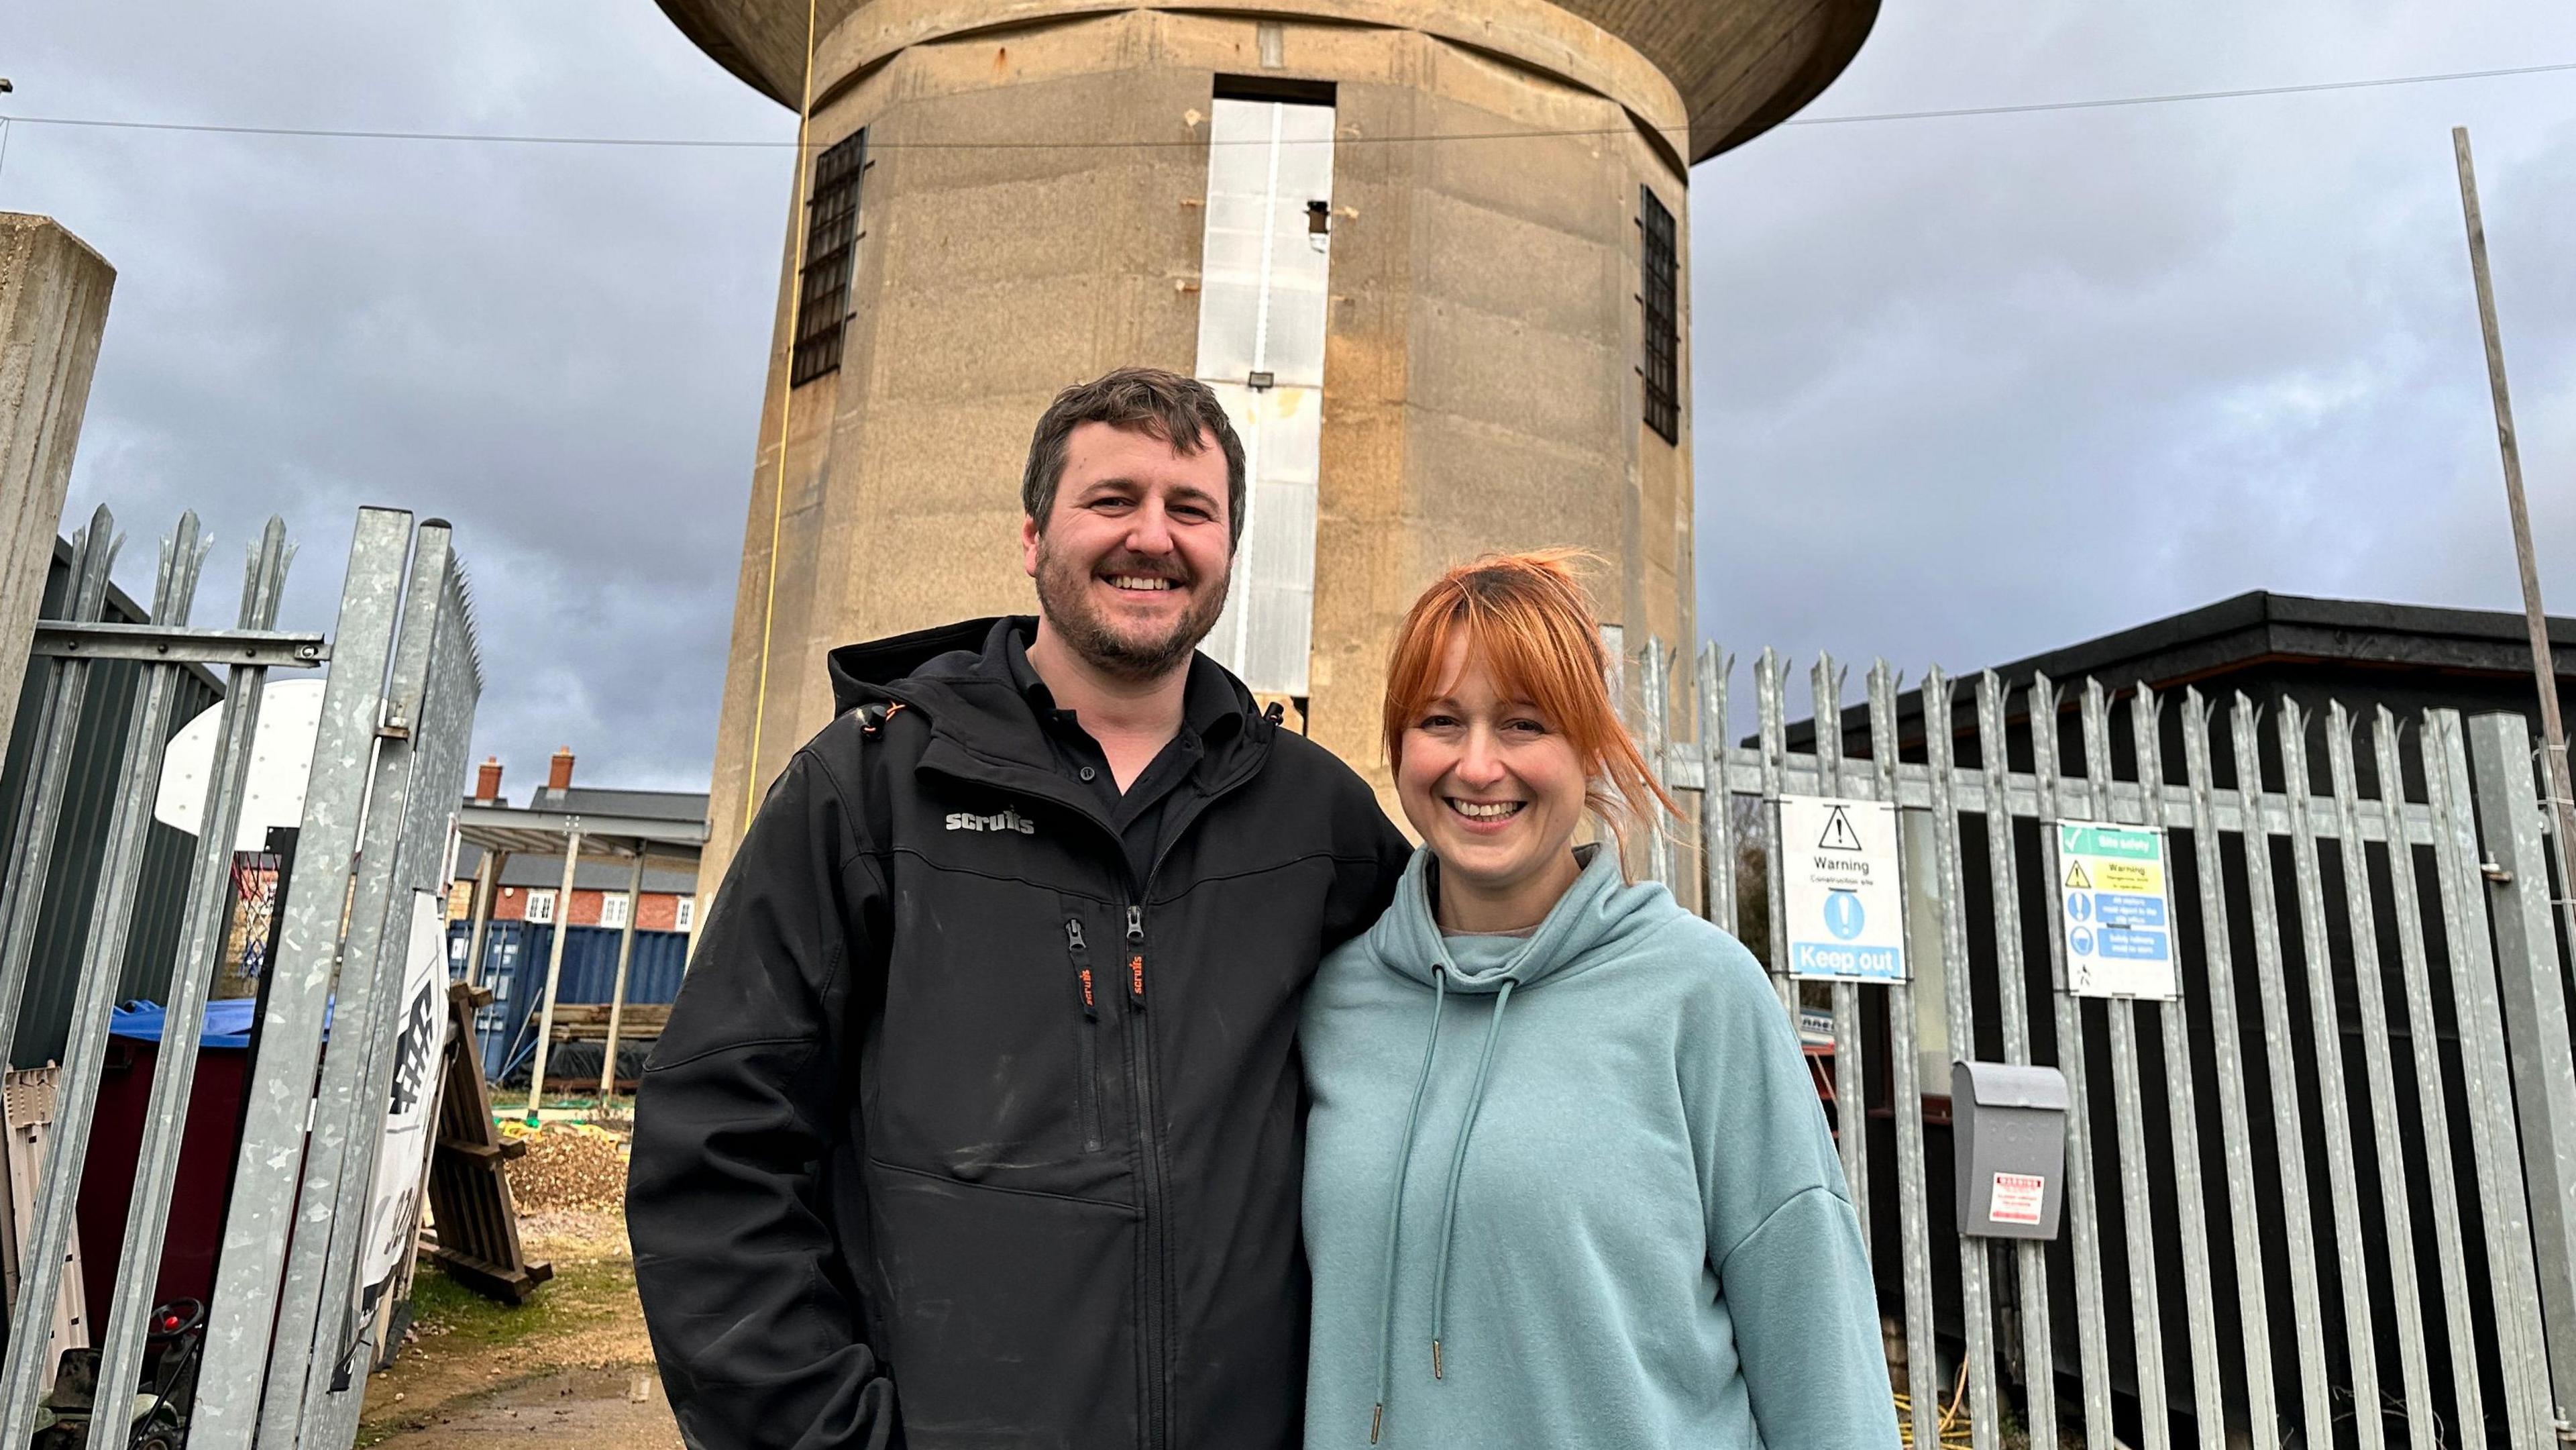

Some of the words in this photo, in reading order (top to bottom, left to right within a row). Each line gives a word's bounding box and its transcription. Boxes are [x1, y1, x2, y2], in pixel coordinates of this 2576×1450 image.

[1814, 856, 1869, 876] Warning
[2109, 863, 2145, 876] Warning
[1801, 945, 1855, 974] Keep
[1859, 951, 1894, 972] out
